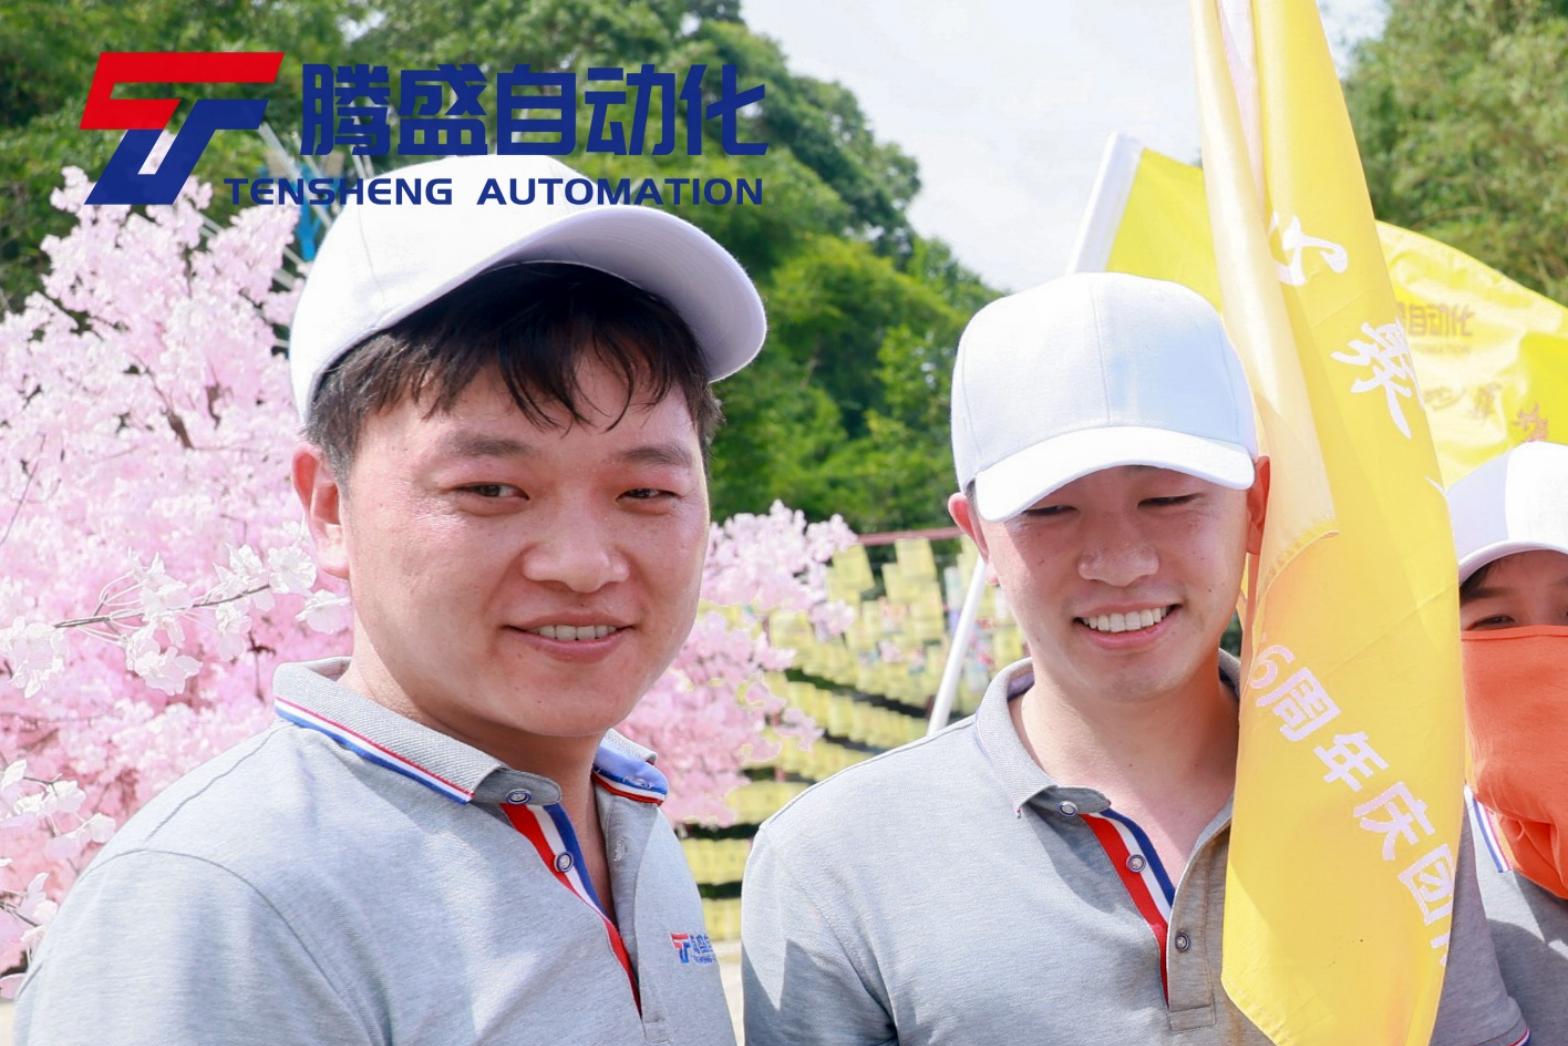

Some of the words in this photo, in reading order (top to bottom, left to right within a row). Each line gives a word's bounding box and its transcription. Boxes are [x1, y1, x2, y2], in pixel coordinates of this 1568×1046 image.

[1398, 303, 1475, 337] 自动化
[1248, 644, 1455, 967] 6周年庆团
